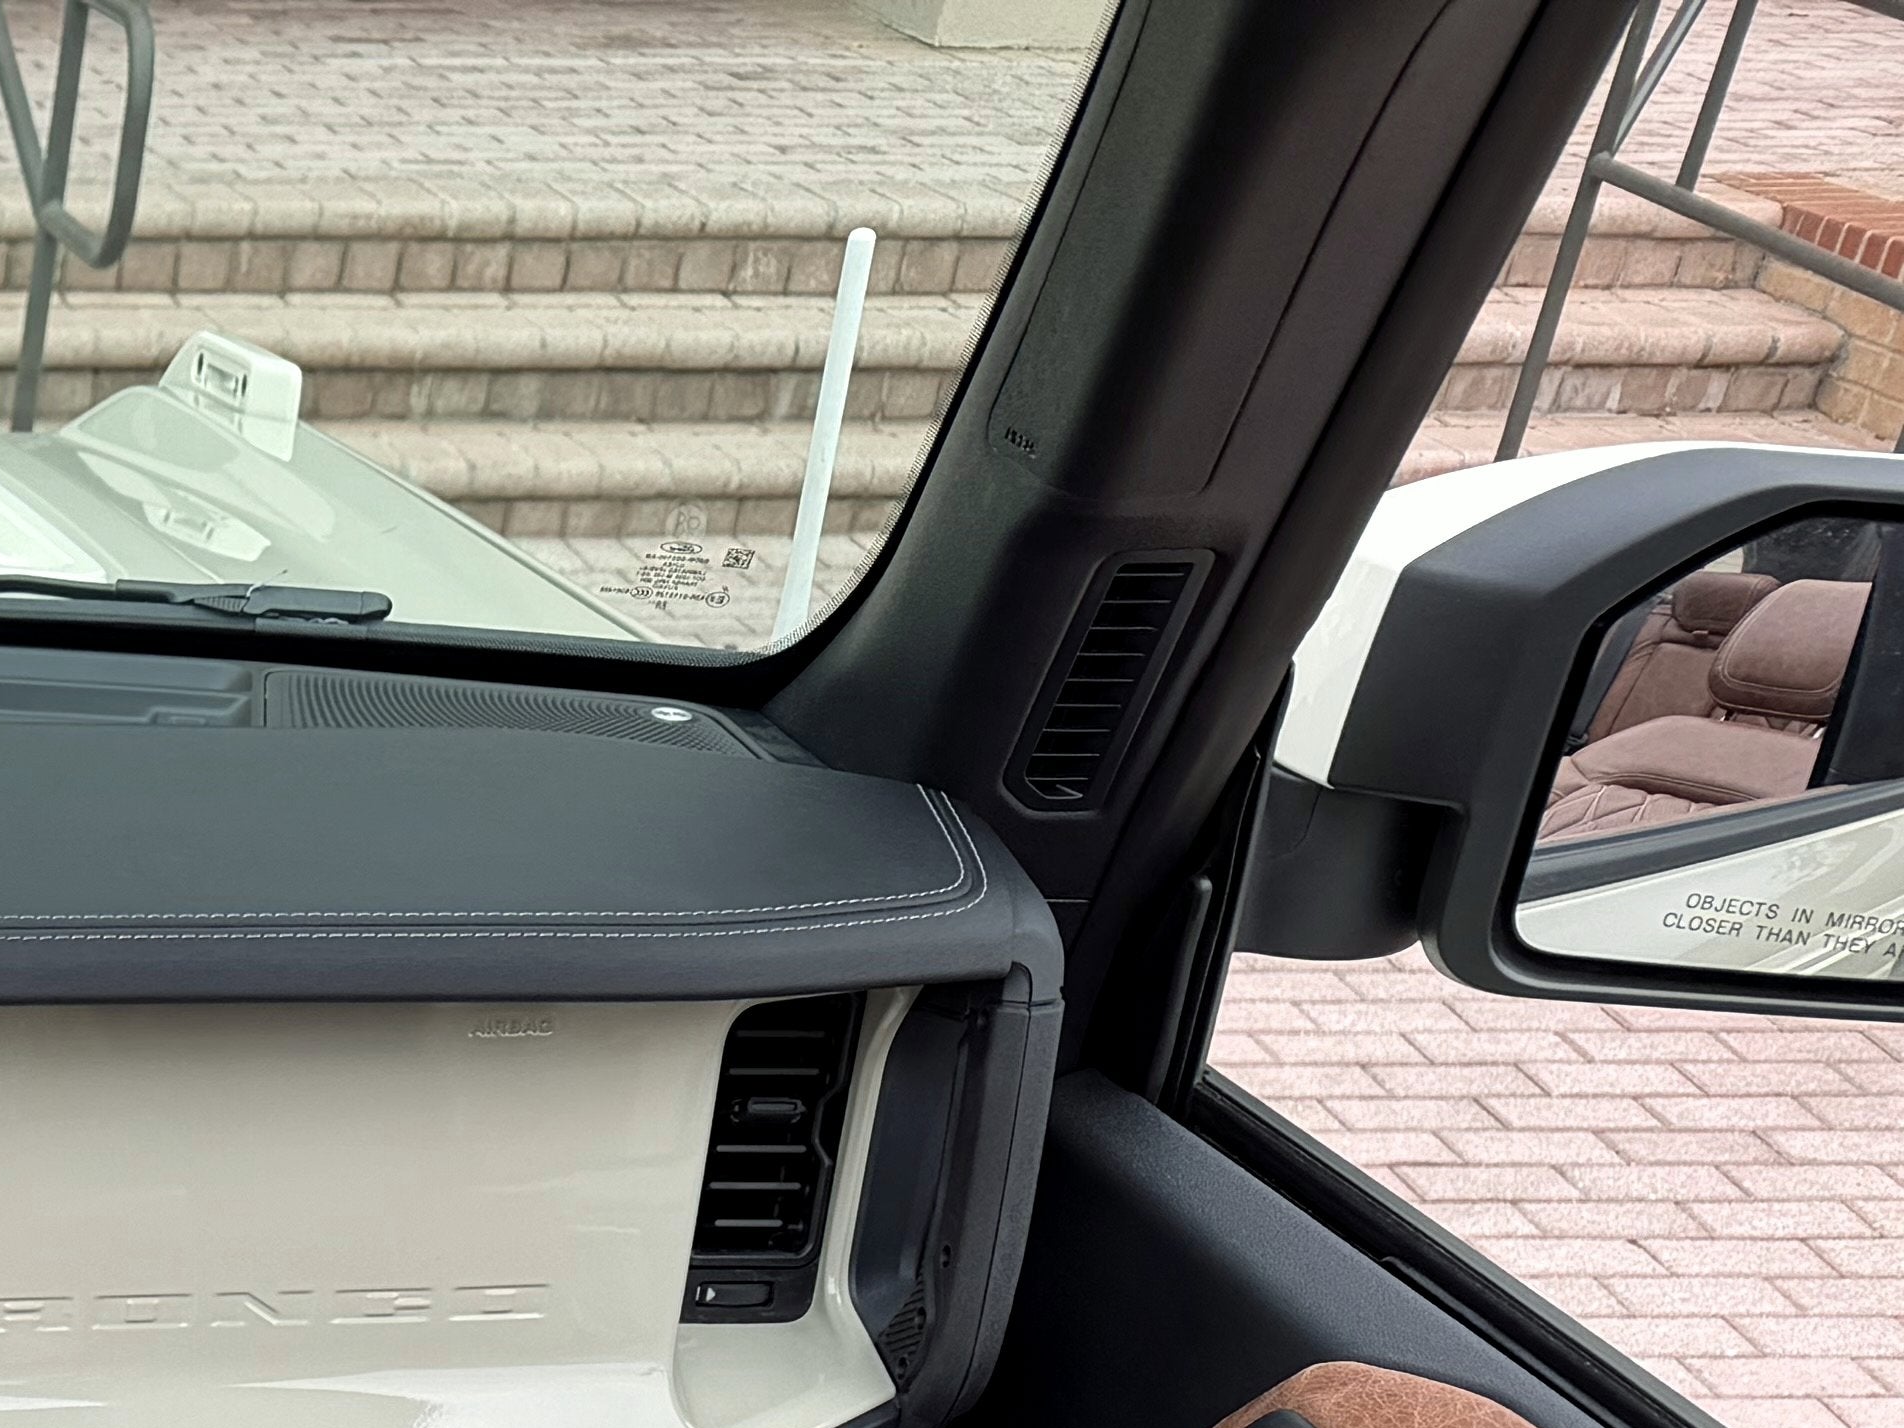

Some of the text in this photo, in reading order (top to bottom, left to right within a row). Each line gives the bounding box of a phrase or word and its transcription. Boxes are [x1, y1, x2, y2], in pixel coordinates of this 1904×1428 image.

[1685, 892, 1780, 920] OBJECTS
[1791, 907, 1814, 925] IN
[1662, 911, 1743, 938] CLOSER
[1755, 924, 1811, 947] THAN
[1823, 933, 1876, 954] THEY
